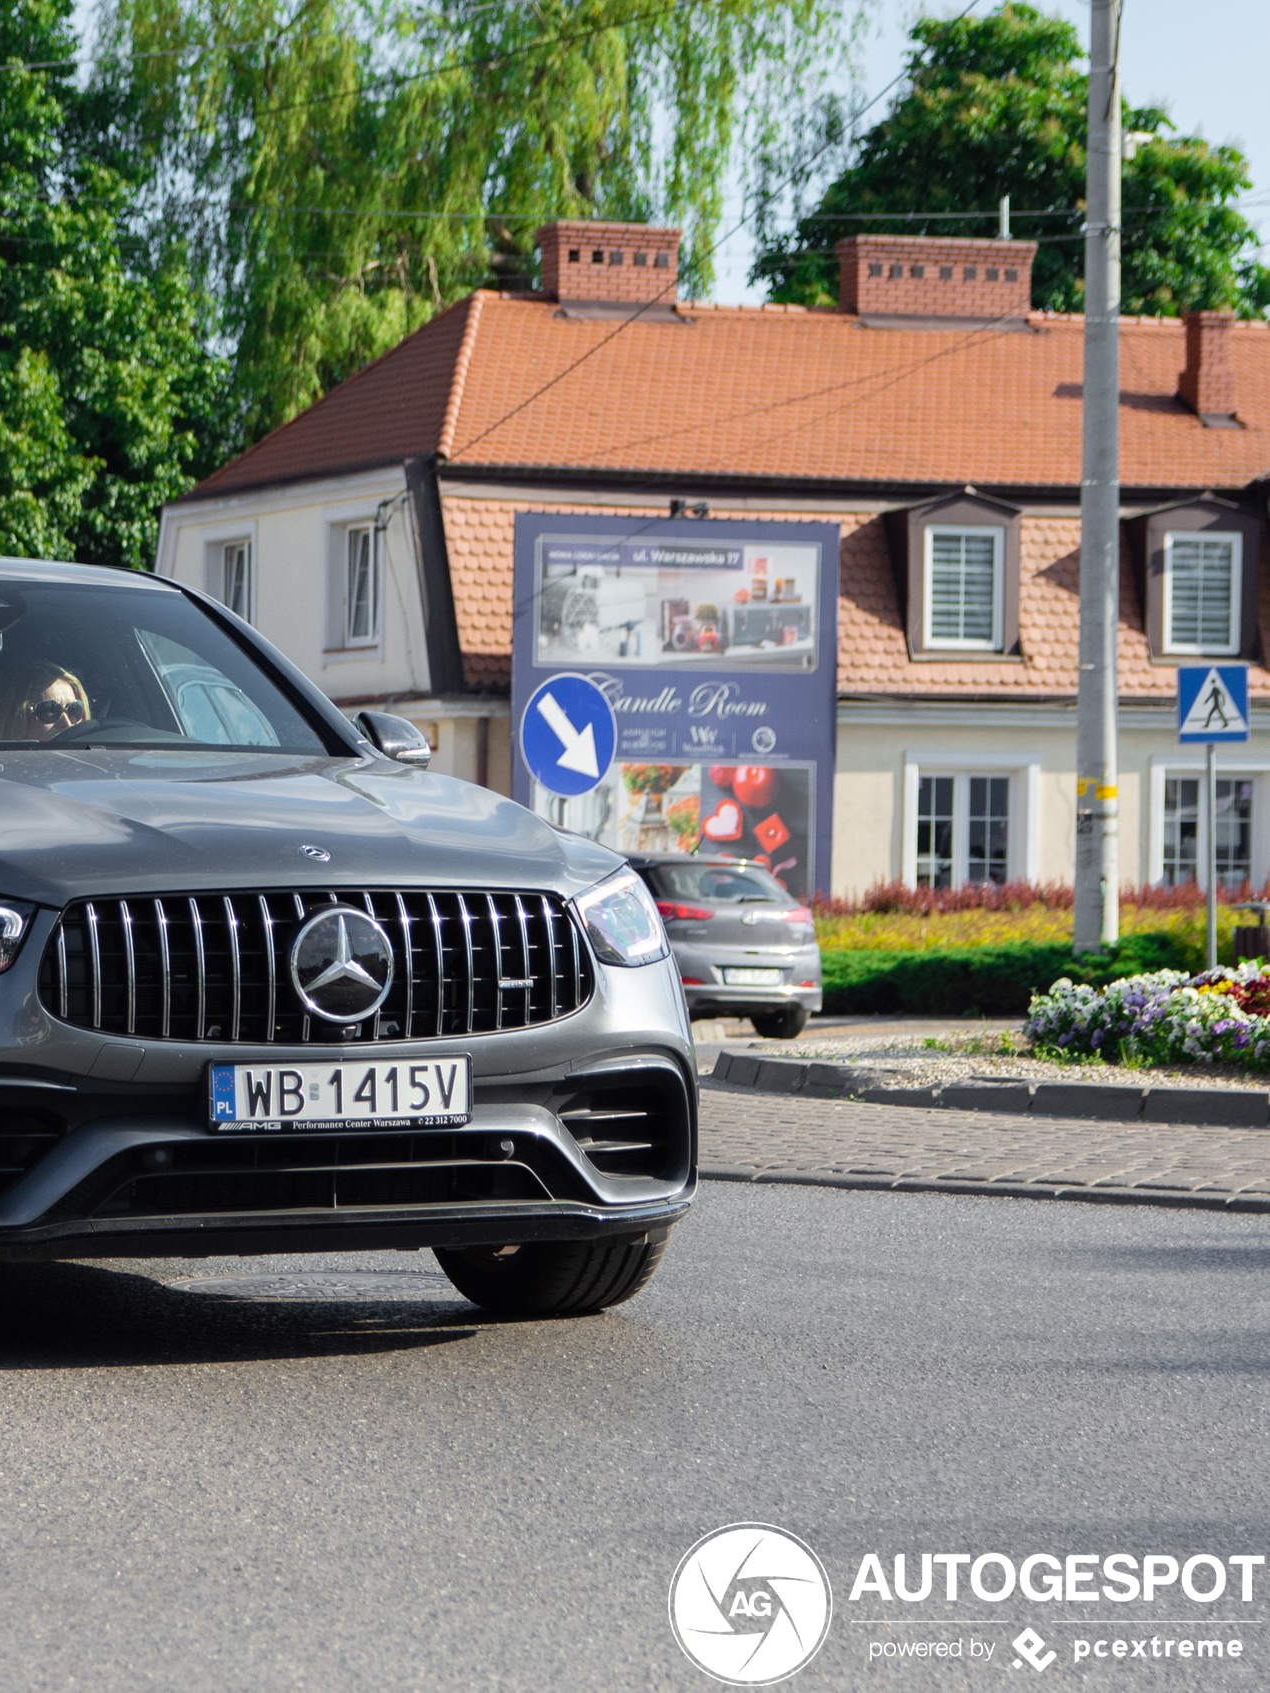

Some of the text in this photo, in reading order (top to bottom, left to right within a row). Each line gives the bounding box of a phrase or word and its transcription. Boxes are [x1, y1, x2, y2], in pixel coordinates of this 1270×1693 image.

[632, 550, 648, 562] ul.
[650, 550, 726, 566] Warszawska
[728, 551, 740, 565] 17
[687, 681, 768, 719] Room
[245, 1063, 458, 1117] WB 1415V
[216, 1102, 233, 1114] PL
[238, 1115, 468, 1130] AMG Performance Center Warszawa 22 312 7000
